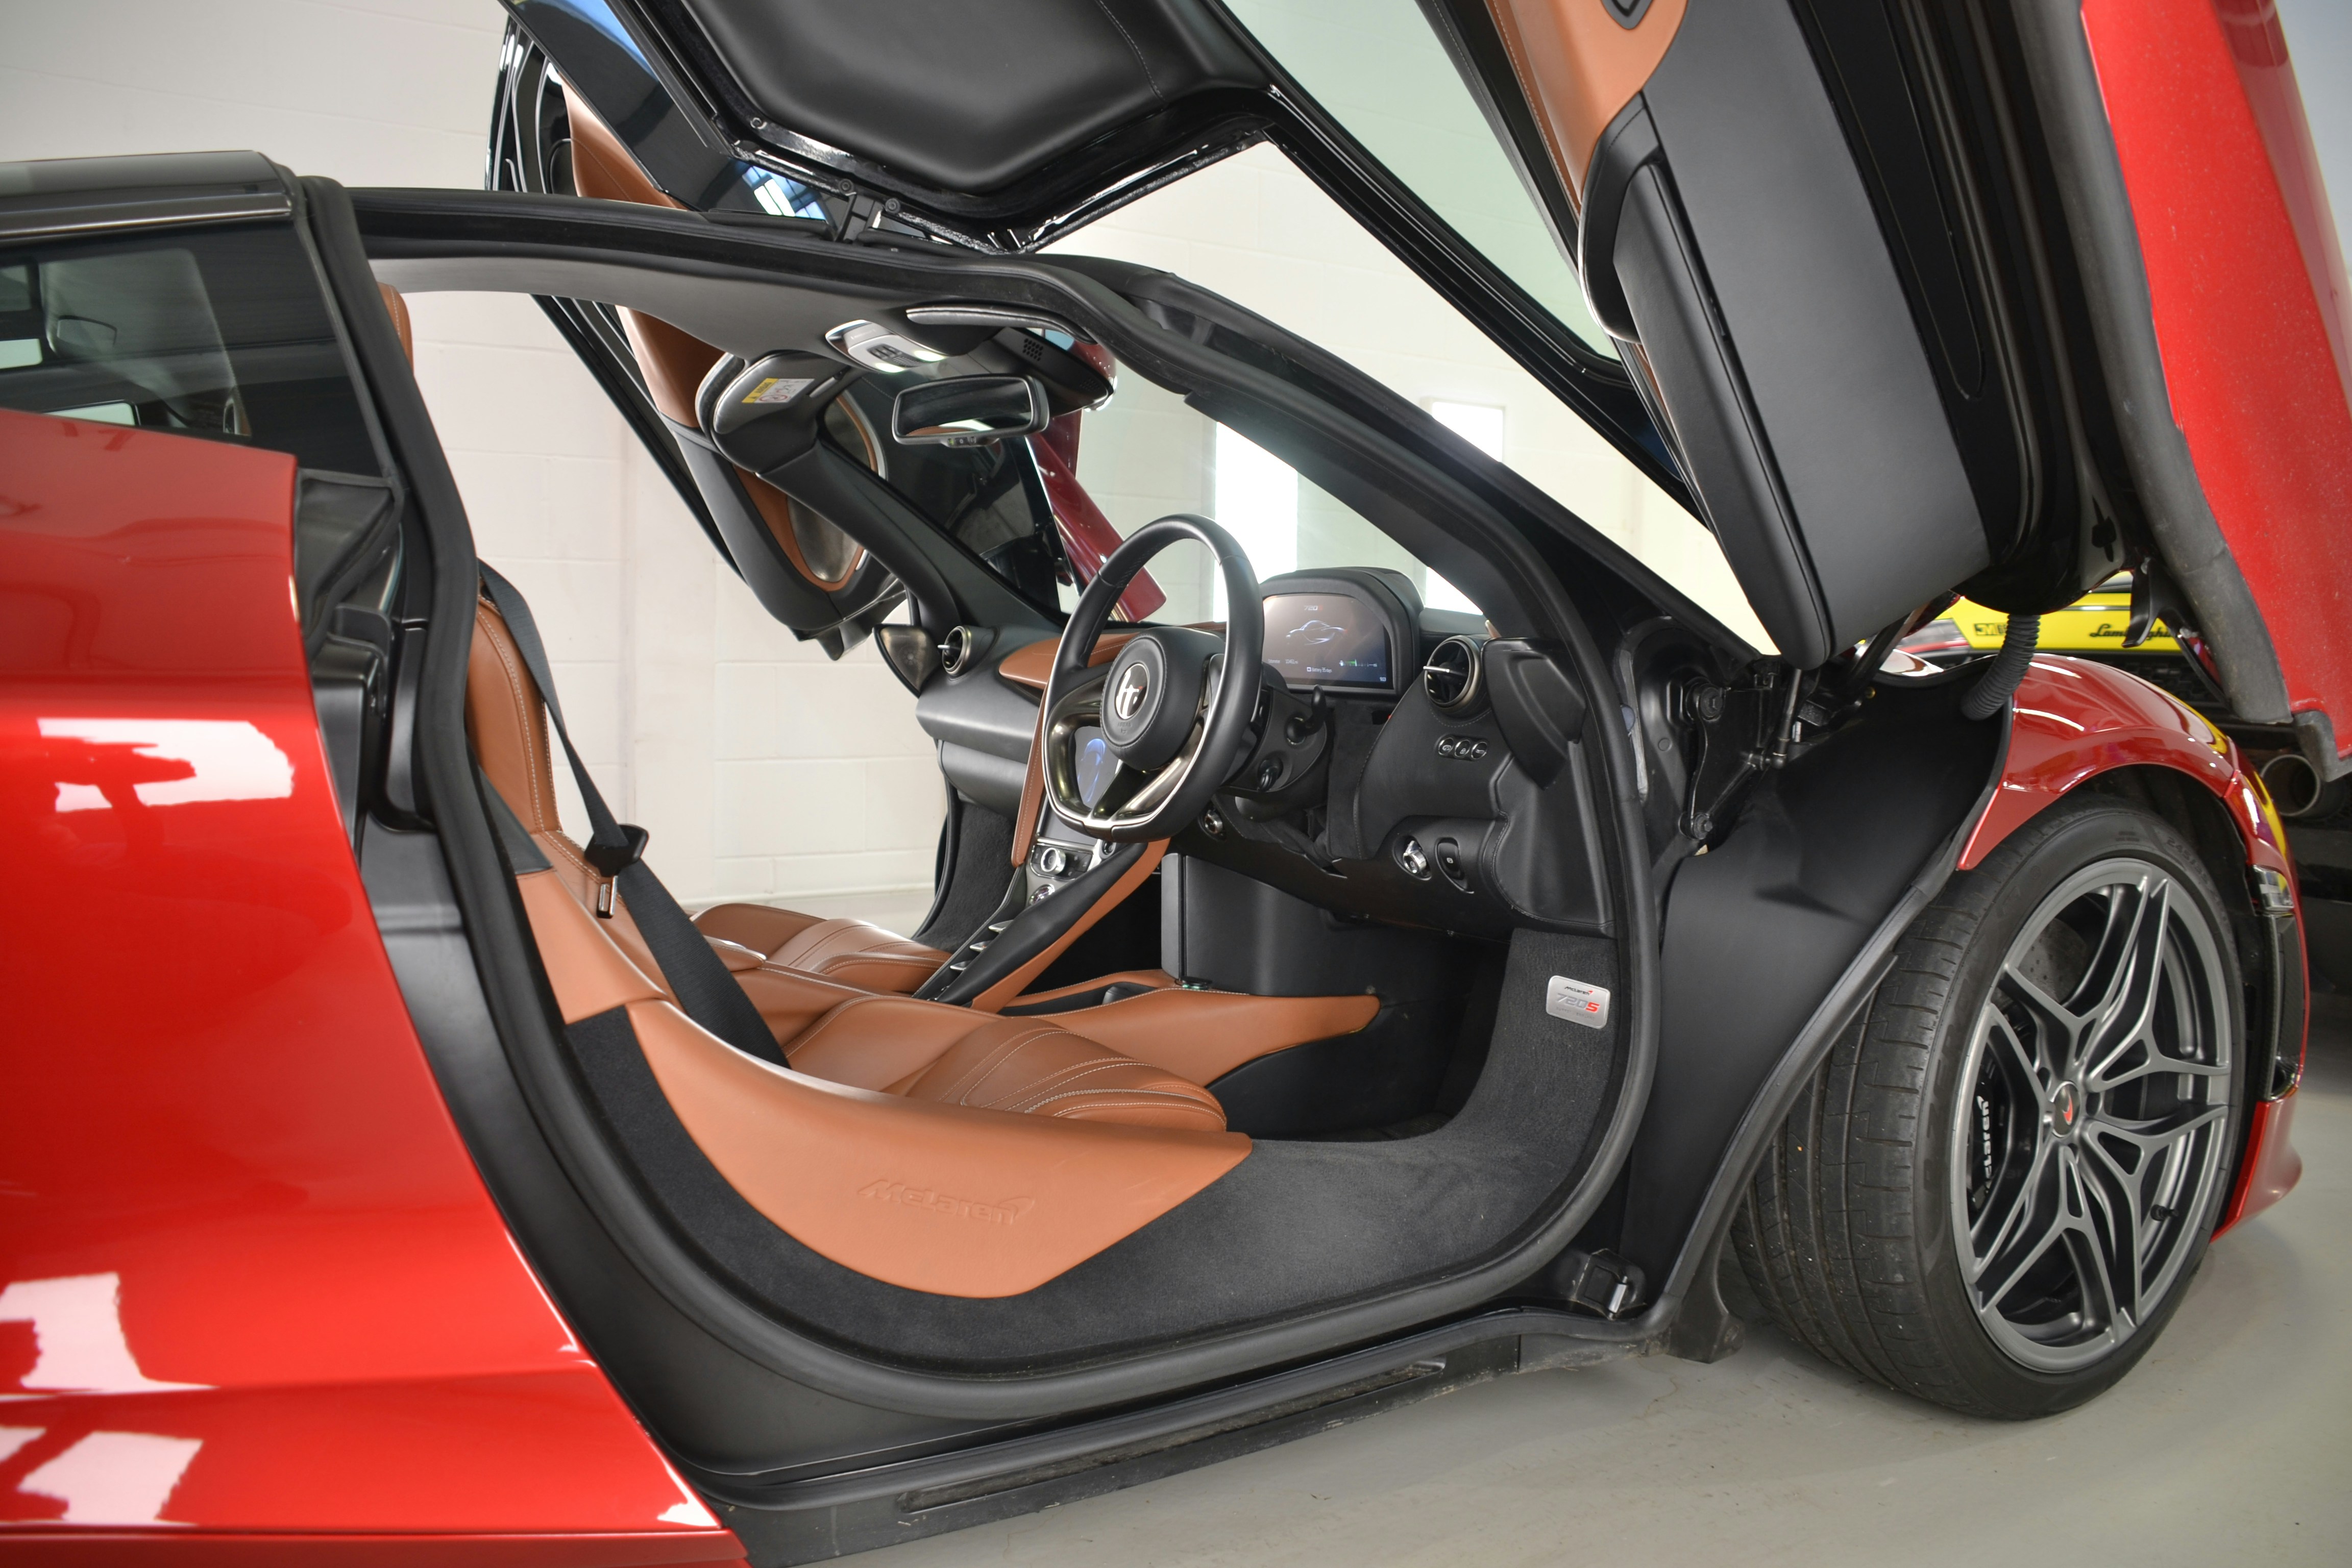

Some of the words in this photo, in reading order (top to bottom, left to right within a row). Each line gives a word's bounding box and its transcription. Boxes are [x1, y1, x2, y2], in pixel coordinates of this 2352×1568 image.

[1564, 986, 1590, 995] McLaren
[1557, 993, 1600, 1013] 720S
[857, 1179, 1017, 1225] McLaren
